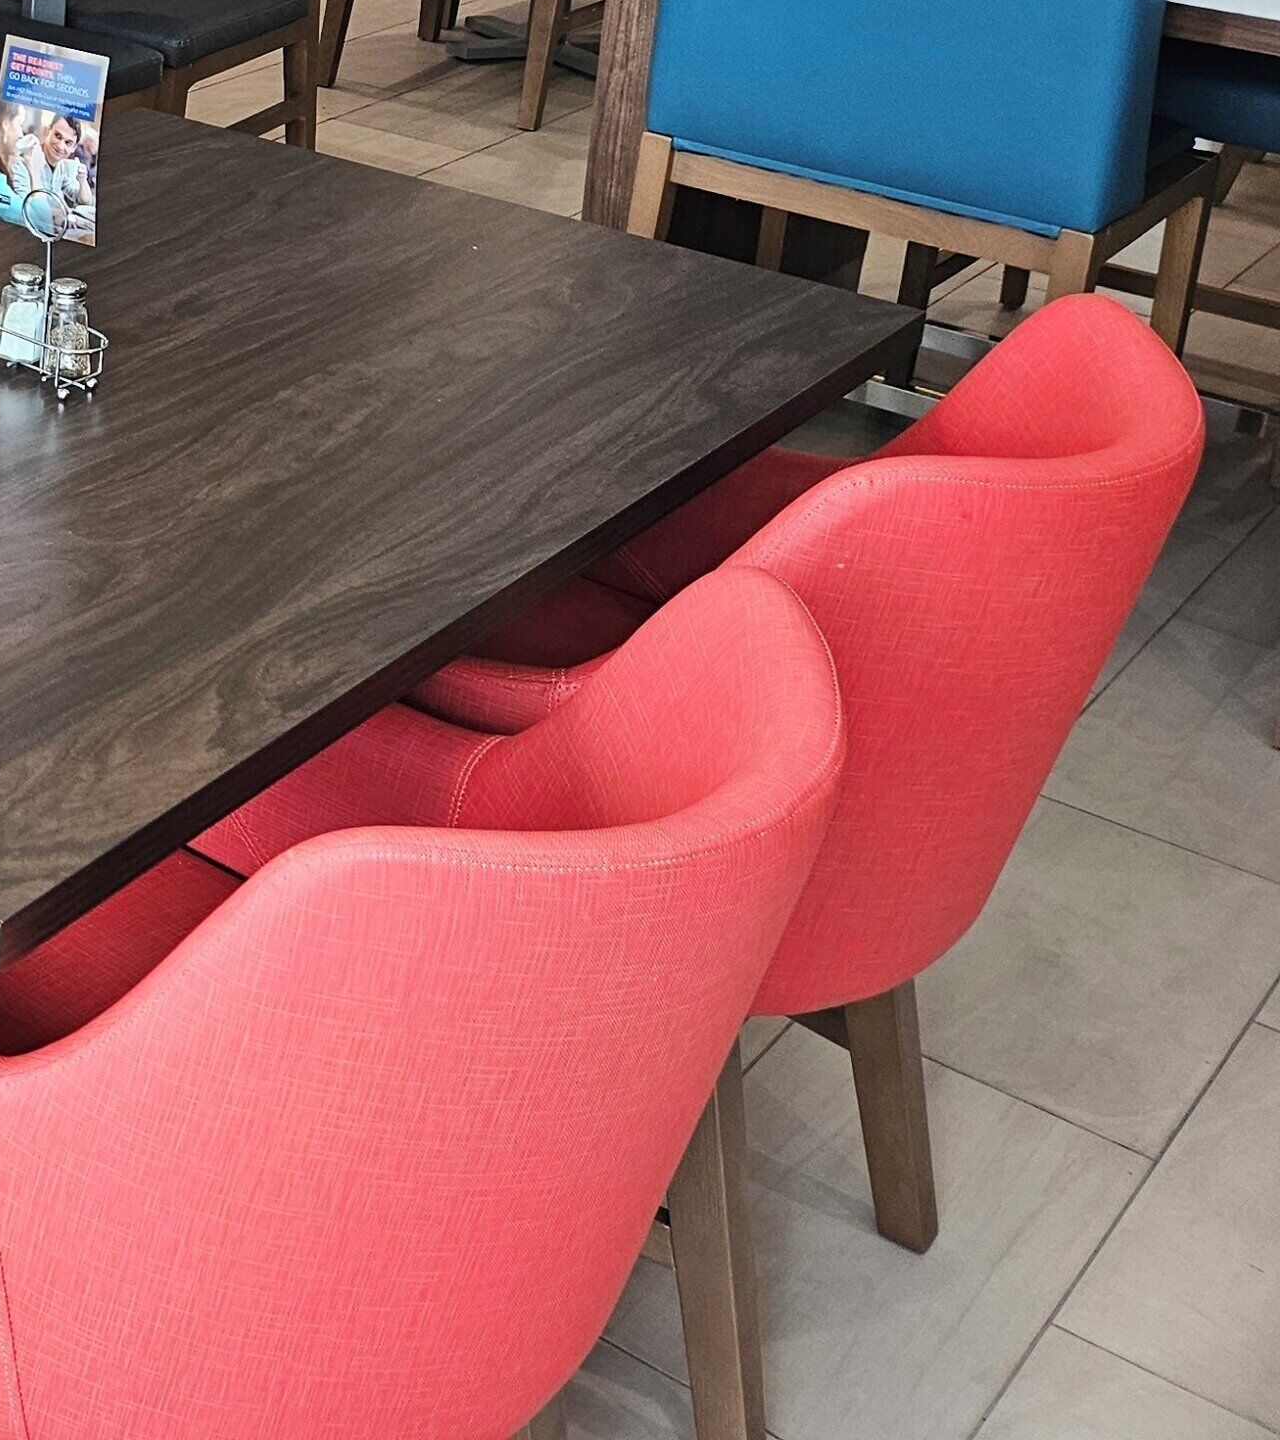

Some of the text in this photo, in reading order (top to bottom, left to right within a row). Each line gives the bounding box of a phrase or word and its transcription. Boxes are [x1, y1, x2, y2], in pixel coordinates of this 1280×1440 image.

[9, 71, 20, 80] GO
[21, 74, 39, 85] BACK
[40, 78, 55, 88] FOR
[57, 72, 75, 85] THEN
